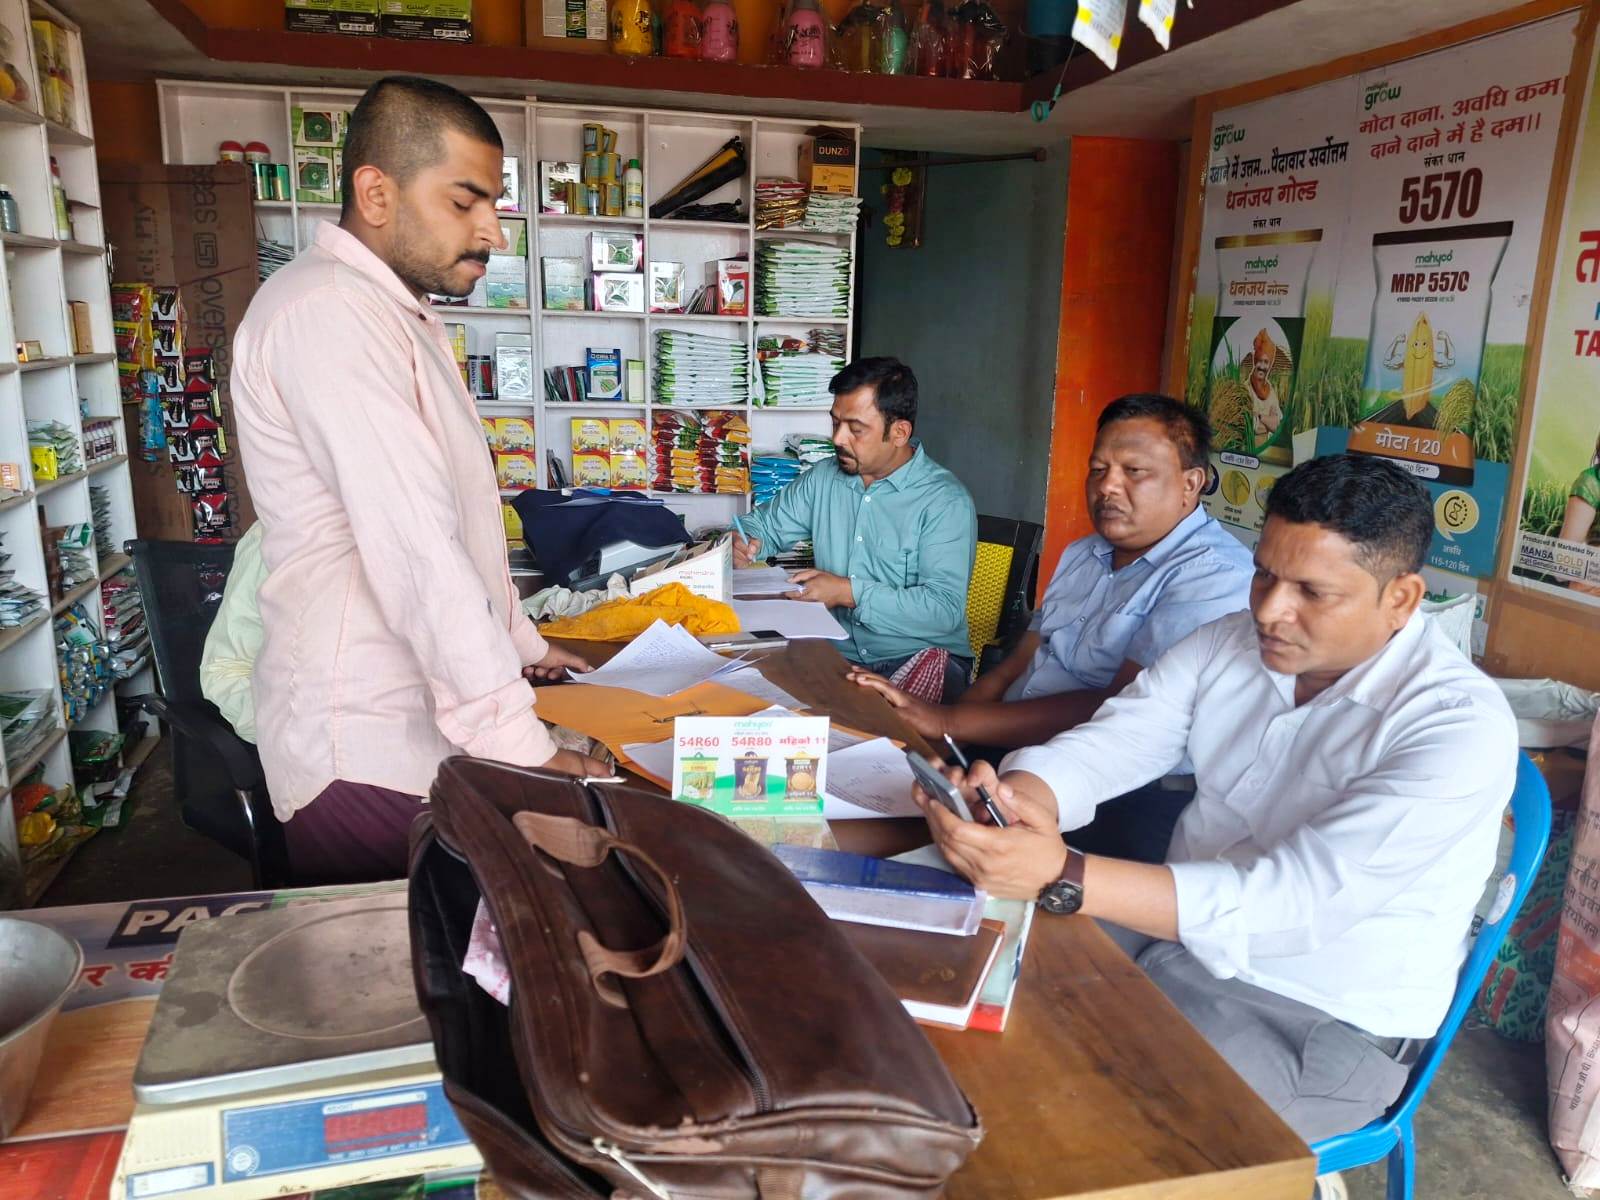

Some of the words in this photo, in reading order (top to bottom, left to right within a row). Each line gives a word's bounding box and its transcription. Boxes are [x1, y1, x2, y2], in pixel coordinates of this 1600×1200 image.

[1360, 112, 1394, 134] मोटा
[1452, 85, 1509, 117] अवधि
[1365, 85, 1402, 110] grow
[1213, 128, 1245, 151] grow
[1370, 135, 1400, 160] दाने
[1407, 128, 1440, 152] दाने
[1447, 121, 1464, 144] में
[1470, 117, 1486, 143] है
[1231, 154, 1240, 180] में
[1308, 135, 1349, 168] सर्वोत्तम
[1424, 152, 1444, 169] संकर
[1448, 151, 1466, 165] धान
[1226, 182, 1274, 210] धनंजय
[1278, 175, 1319, 203] गोल्ड
[1400, 167, 1483, 224] 5570
[1576, 230, 1600, 283] त
[1391, 273, 1425, 293] MRP
[1428, 271, 1470, 292] 5570
[1375, 428, 1409, 450] मोटा
[1414, 439, 1441, 456] 120
[1521, 544, 1554, 560] MANSA
[679, 736, 720, 747] 54R60
[731, 736, 772, 747] 54R80
